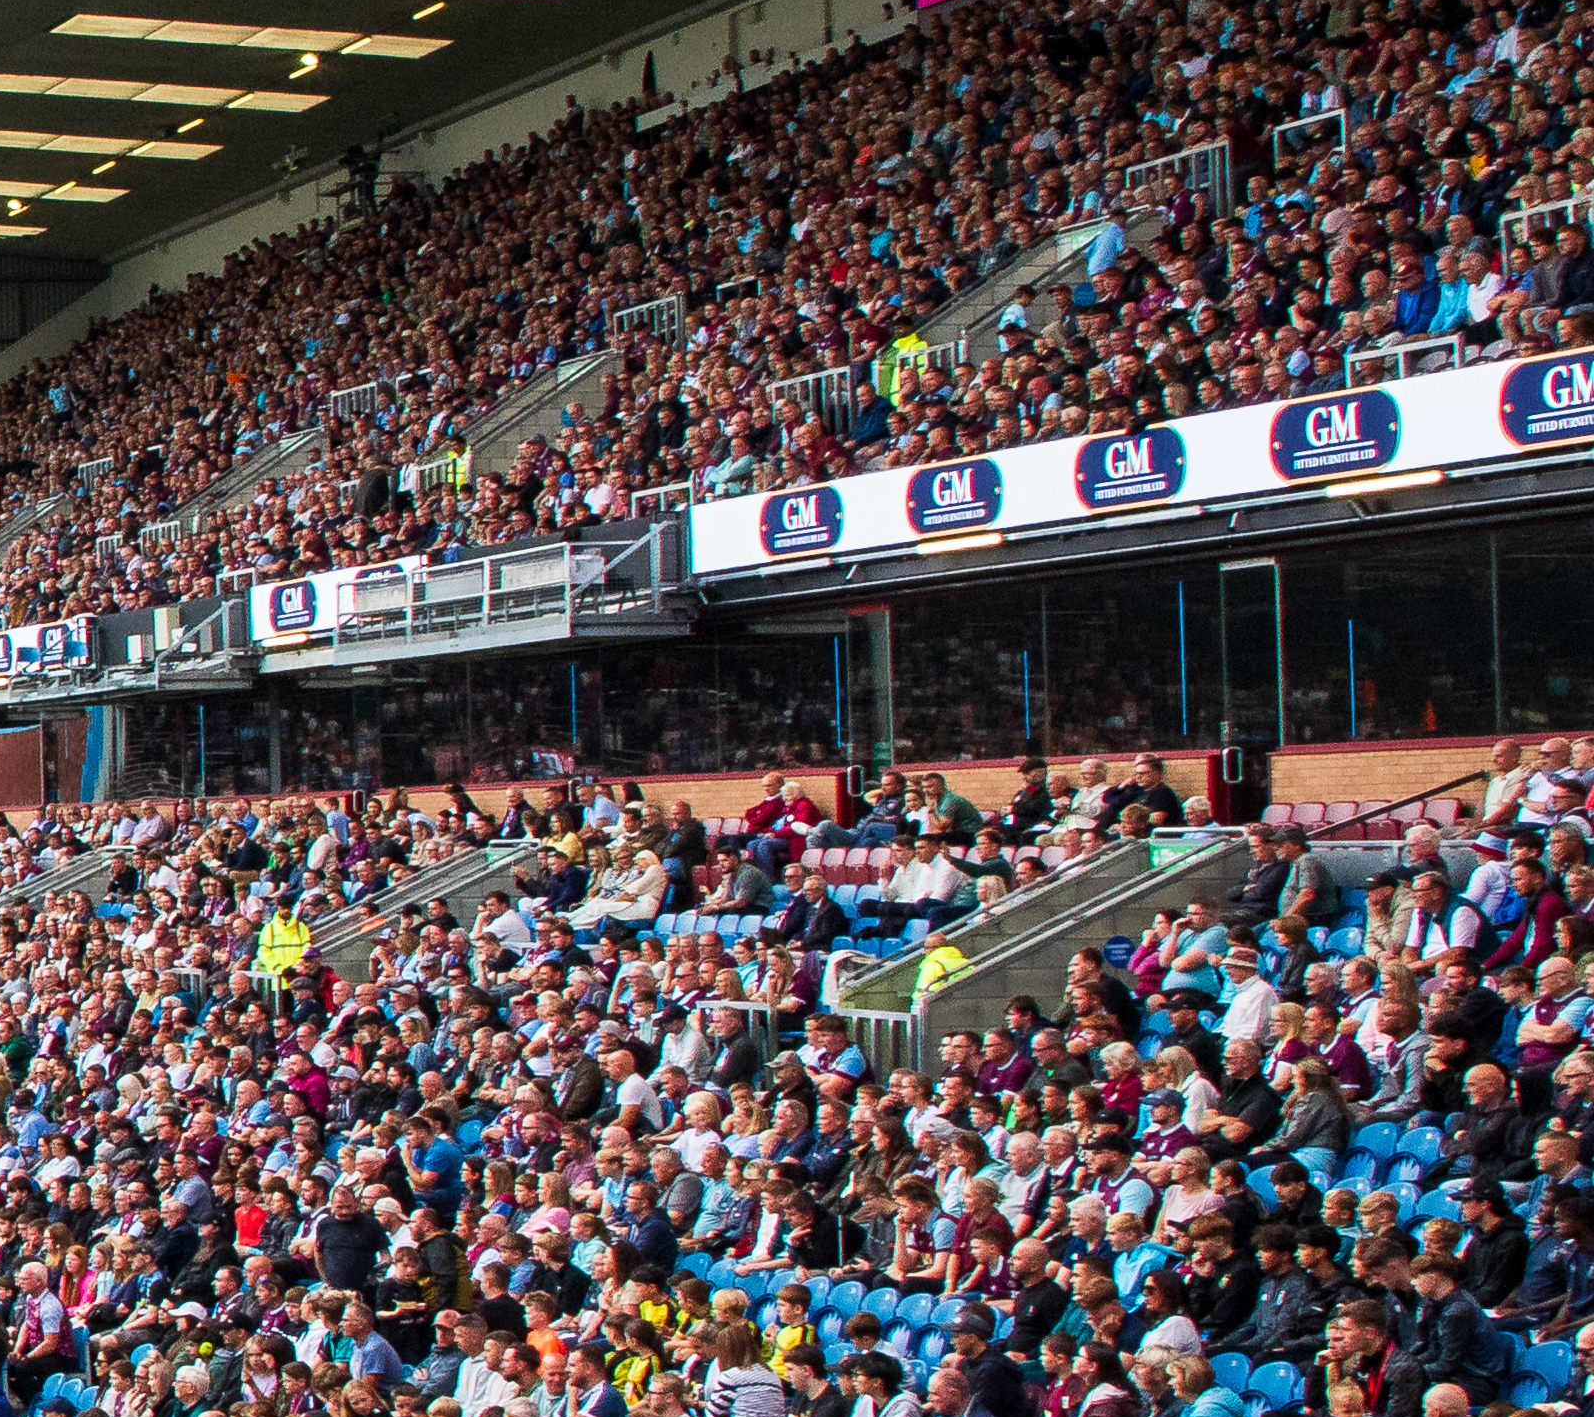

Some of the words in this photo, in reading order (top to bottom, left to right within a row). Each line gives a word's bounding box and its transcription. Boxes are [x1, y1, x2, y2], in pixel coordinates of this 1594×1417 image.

[1305, 401, 1361, 448] GM
[1105, 436, 1152, 479] GM
[932, 468, 974, 506] GM
[782, 494, 819, 530] GM
[281, 586, 302, 613] GM
